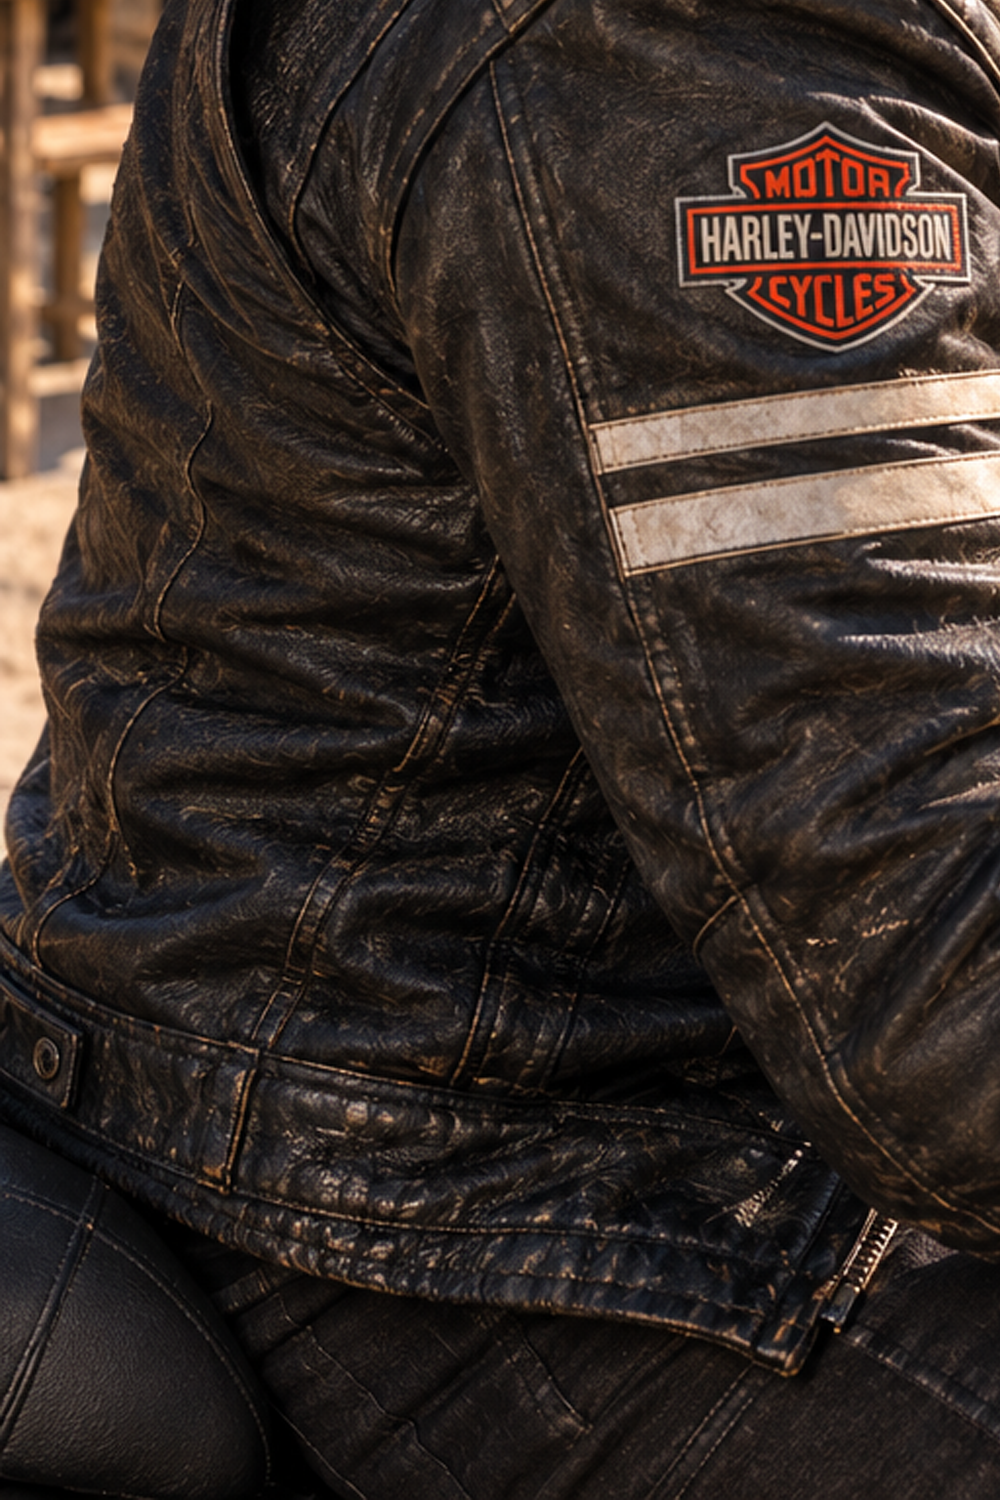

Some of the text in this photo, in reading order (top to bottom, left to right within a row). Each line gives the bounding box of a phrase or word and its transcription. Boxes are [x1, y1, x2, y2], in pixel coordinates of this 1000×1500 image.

[764, 148, 890, 199] MOTOR
[701, 213, 951, 263] HARLEY-DAVIDSON
[768, 274, 896, 328] CYCLES
